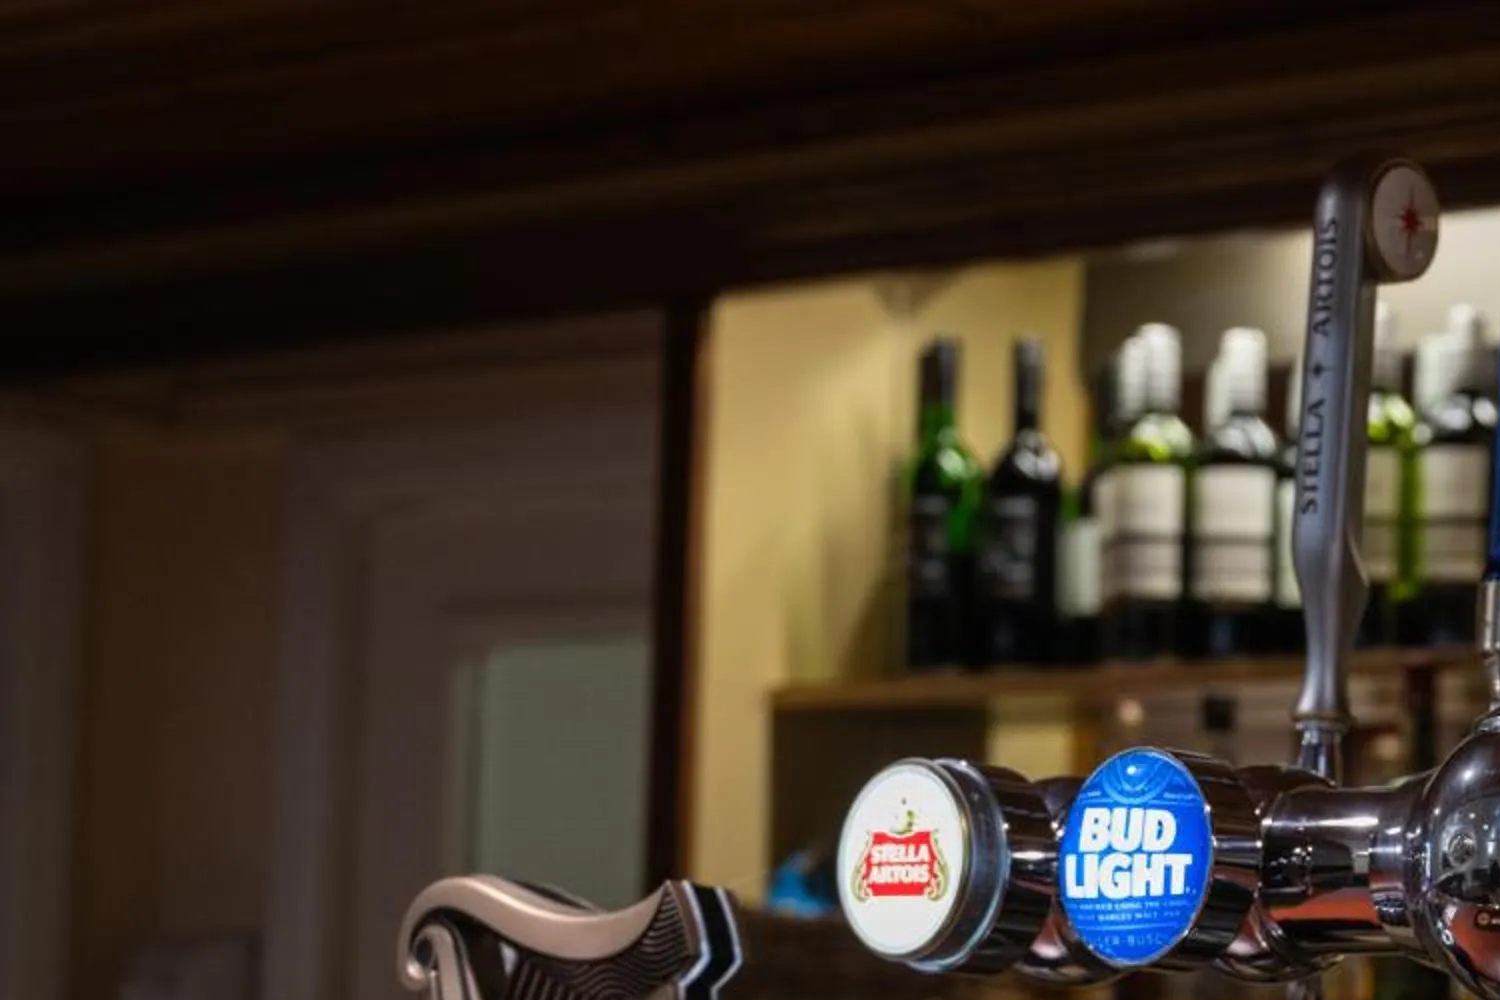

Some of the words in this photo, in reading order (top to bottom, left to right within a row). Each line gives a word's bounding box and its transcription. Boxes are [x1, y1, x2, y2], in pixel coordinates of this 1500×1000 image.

[1312, 216, 1340, 337] ARTOIS
[1299, 399, 1326, 515] STELLA
[1079, 807, 1177, 852] BUD
[868, 864, 930, 884] ARTOIS
[871, 843, 930, 864] STELLA
[1065, 853, 1193, 899] LIGHT
